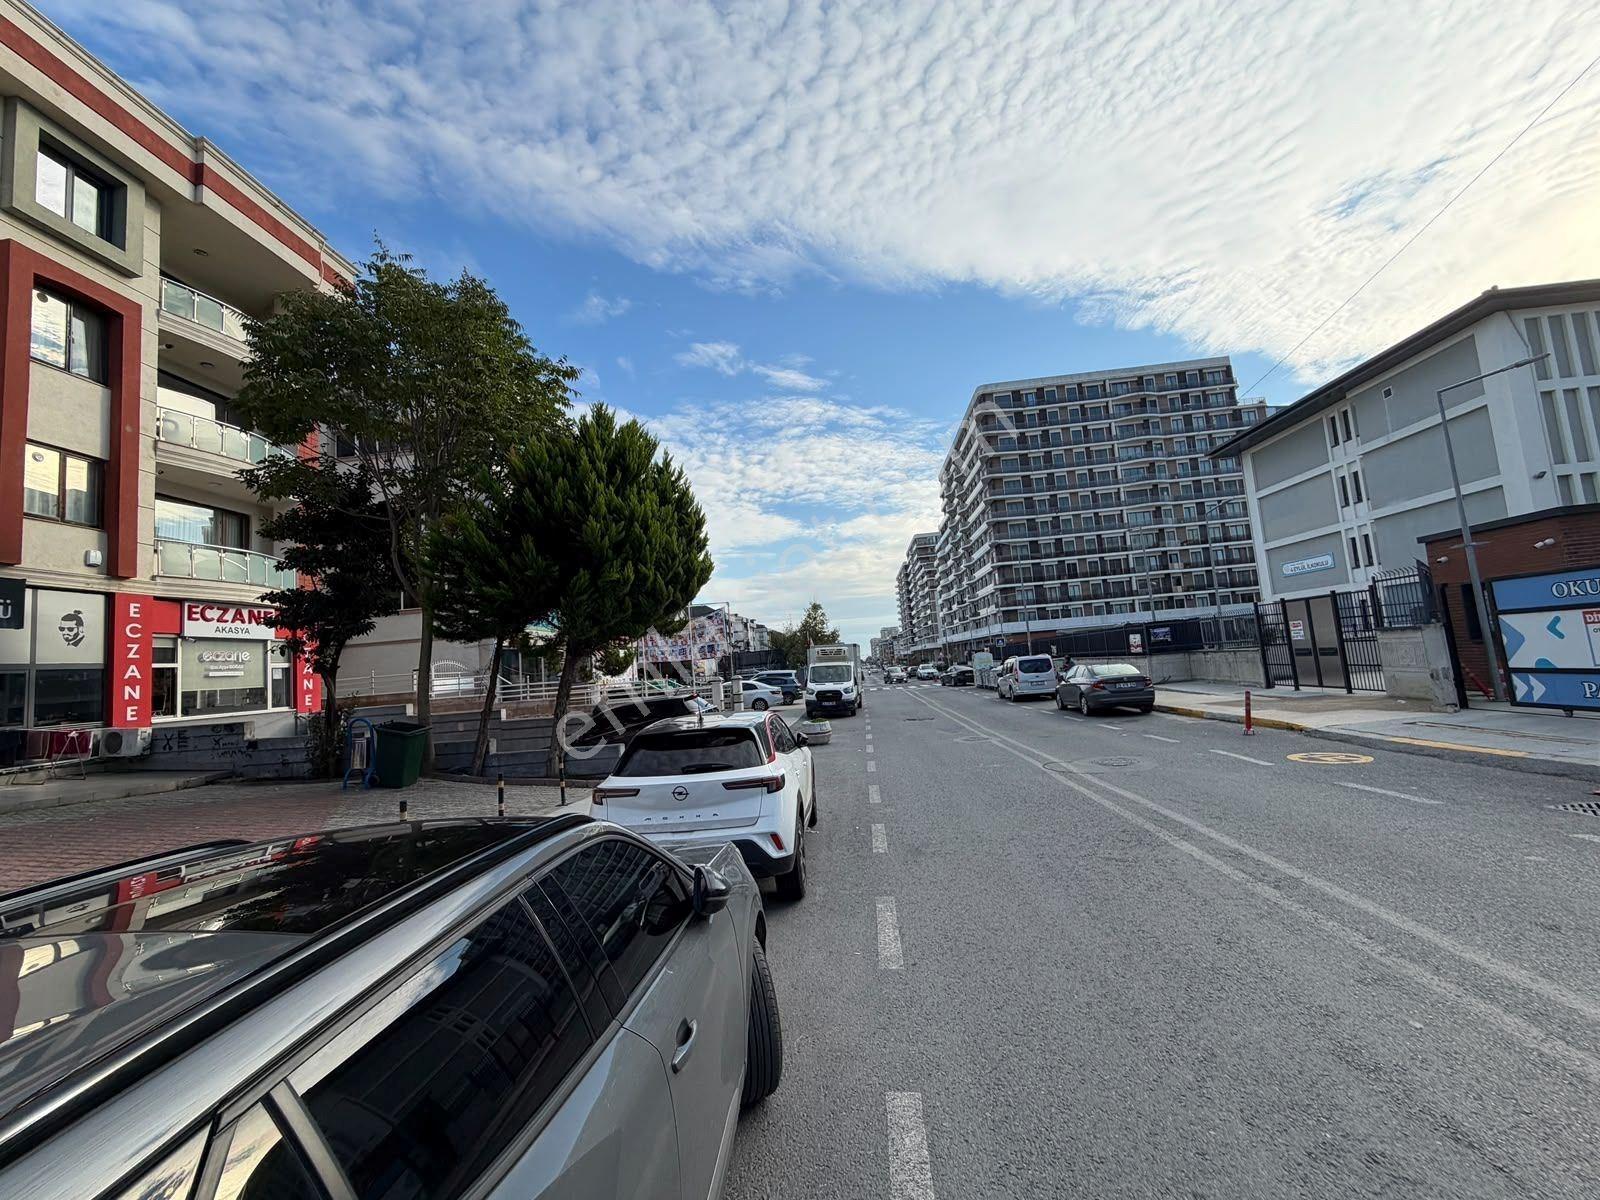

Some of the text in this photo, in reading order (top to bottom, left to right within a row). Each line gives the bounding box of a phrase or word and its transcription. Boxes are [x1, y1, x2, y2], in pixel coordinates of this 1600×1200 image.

[214, 626, 251, 635] AKASYA
[124, 603, 142, 721] ECZANE
[203, 651, 250, 662] eczane
[1582, 681, 1600, 698] P
